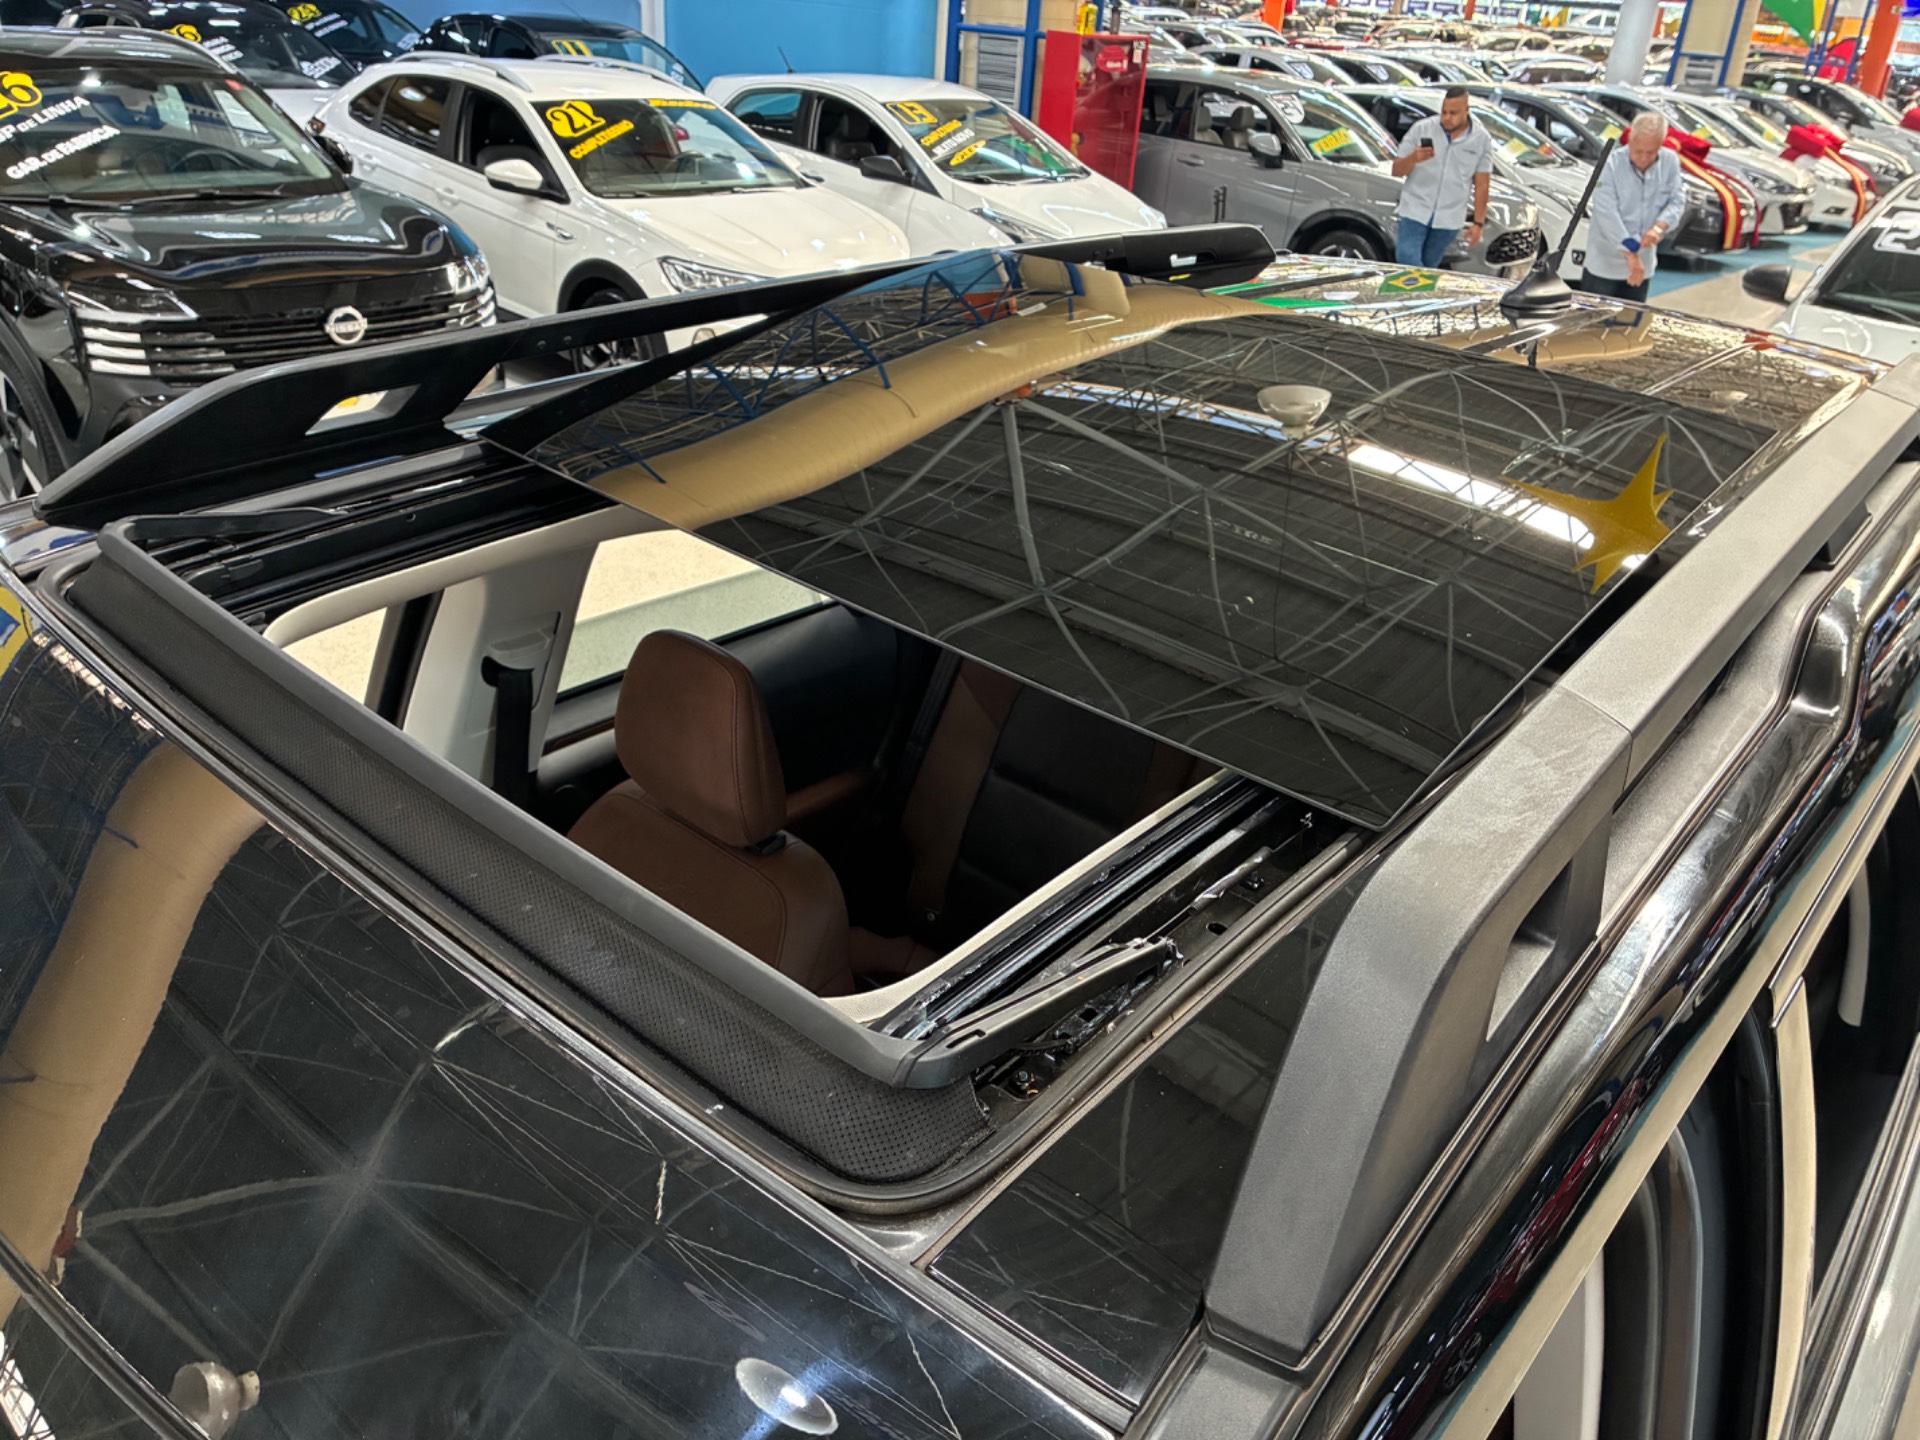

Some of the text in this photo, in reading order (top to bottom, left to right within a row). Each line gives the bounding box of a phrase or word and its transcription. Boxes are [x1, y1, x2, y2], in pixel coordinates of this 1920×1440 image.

[16, 119, 38, 132] DE
[32, 96, 90, 124] LINHA
[548, 102, 604, 135] 21
